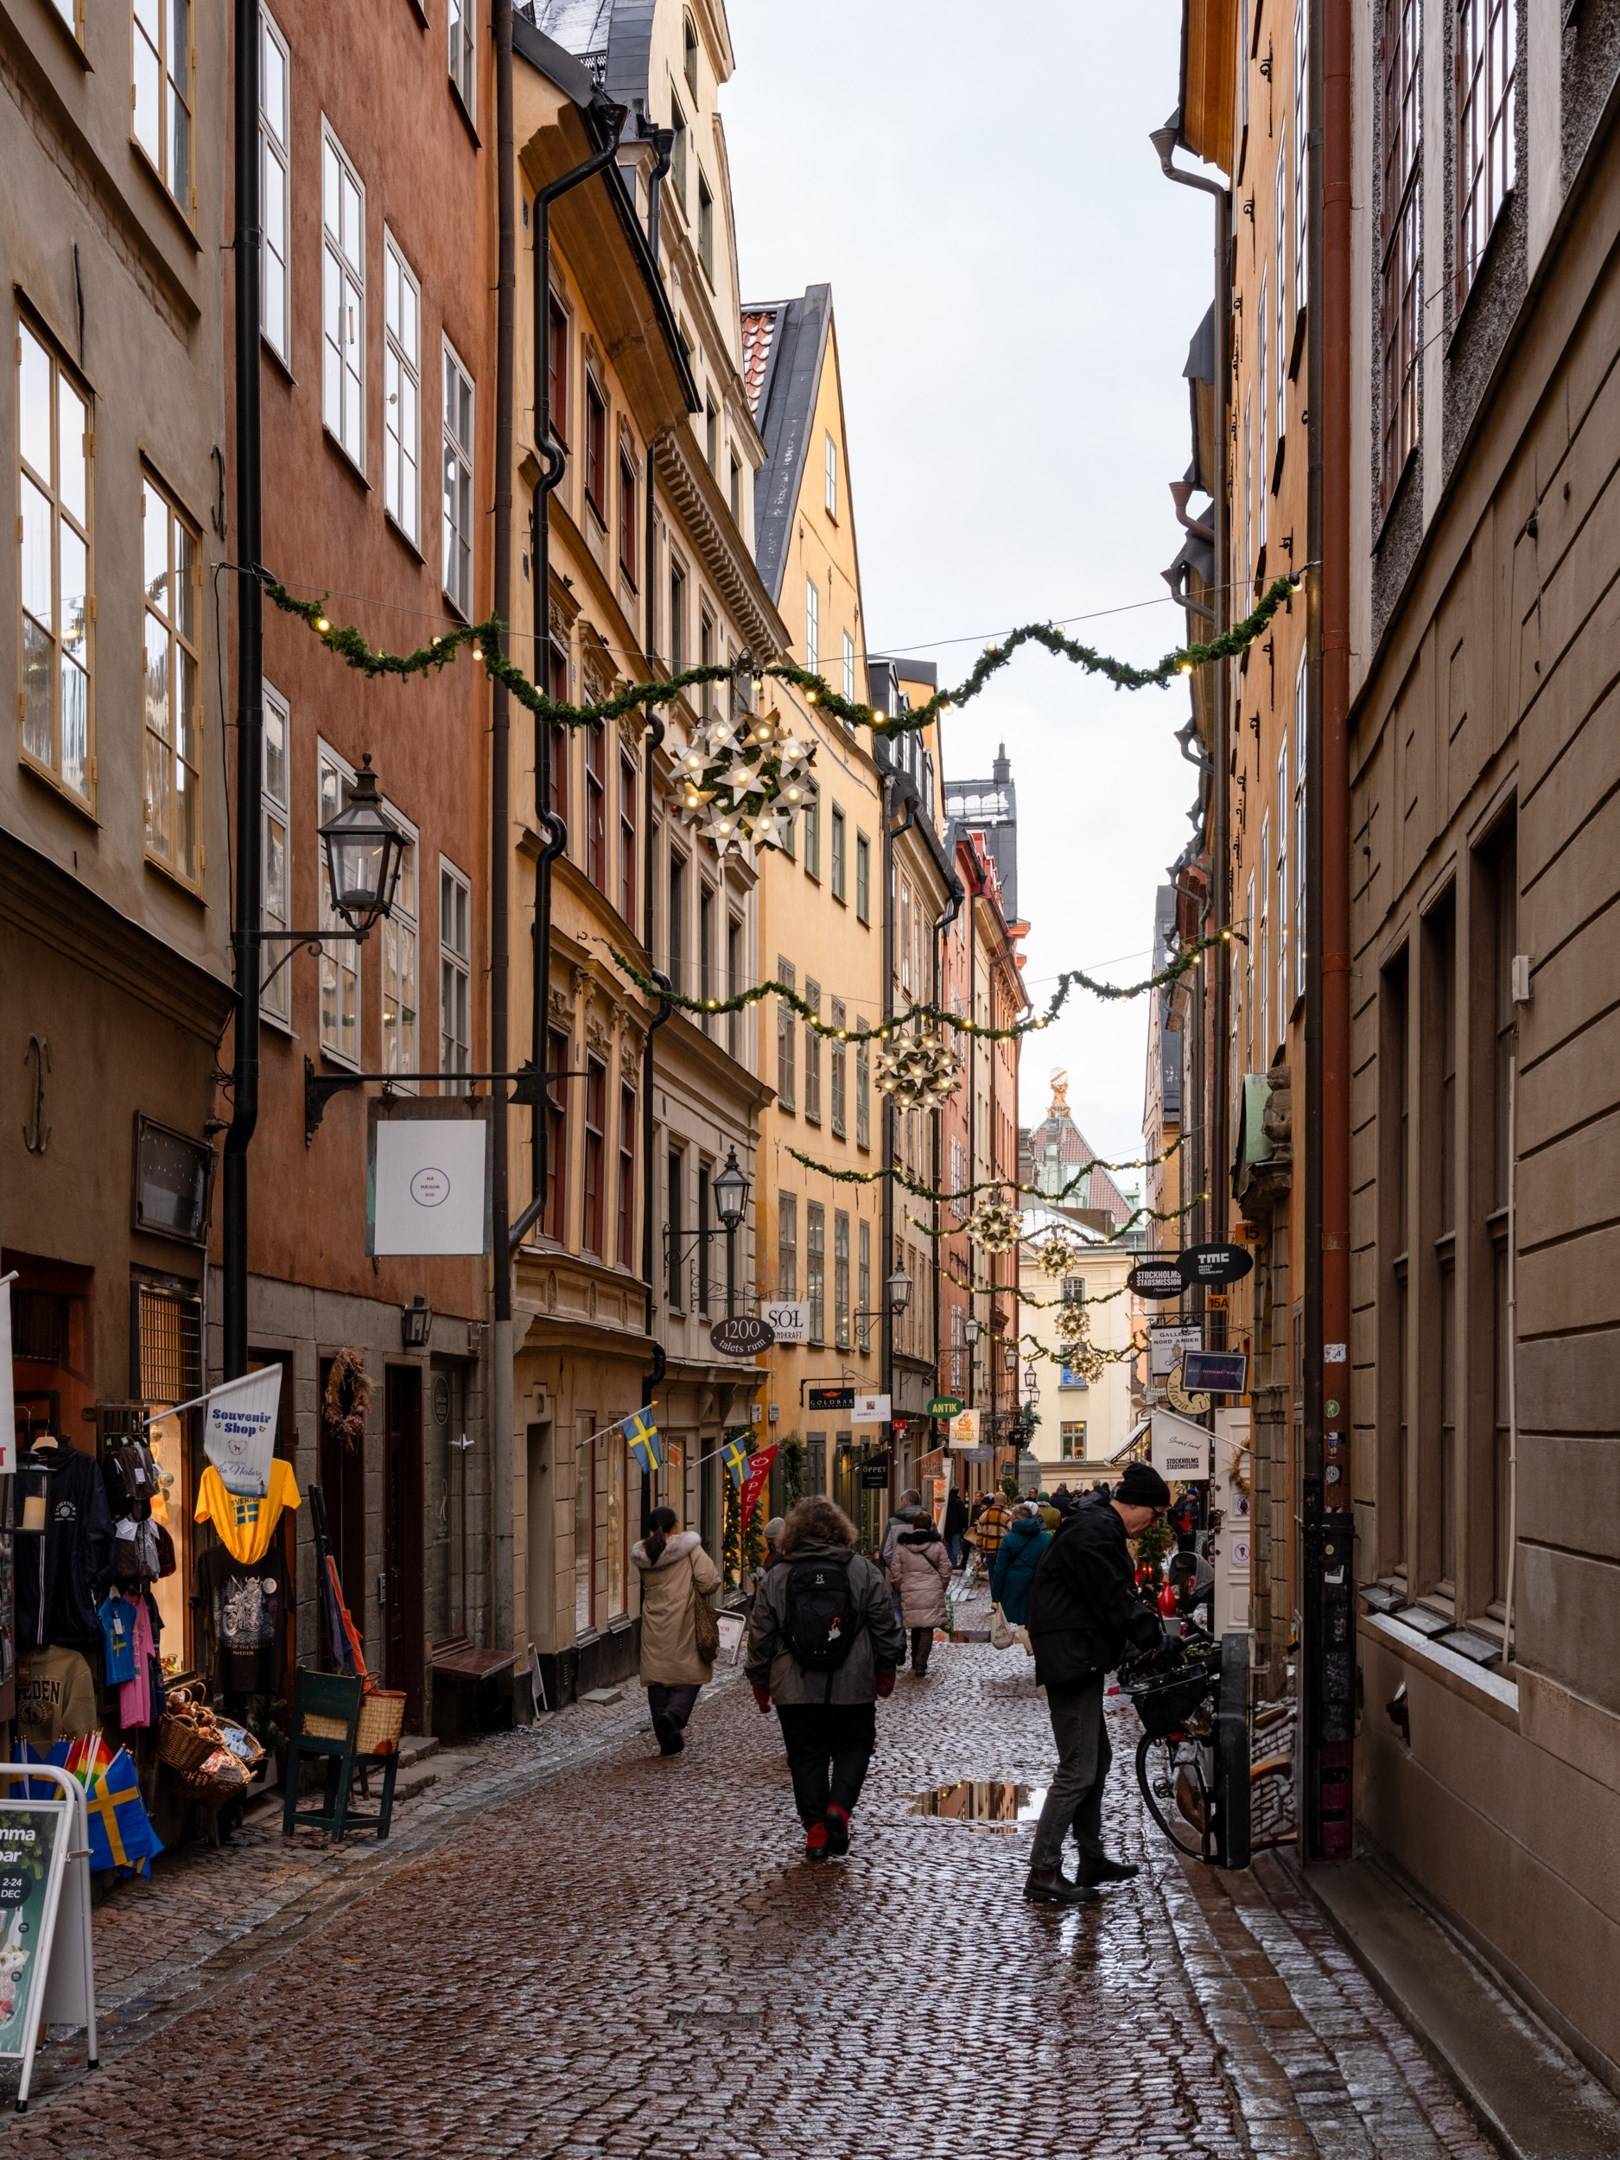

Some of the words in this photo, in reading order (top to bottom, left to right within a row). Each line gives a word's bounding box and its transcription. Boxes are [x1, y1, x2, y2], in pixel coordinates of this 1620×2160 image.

[1244, 1225, 1260, 1240] 15
[1198, 1253, 1230, 1264] TMC
[1136, 1270, 1181, 1279] STOCKHOLMS
[1210, 1298, 1228, 1308] 15A
[725, 1319, 760, 1339] 1200
[774, 1331, 802, 1339] ANDKRAFT
[719, 1339, 744, 1353] talets
[747, 1339, 767, 1352] rum
[1169, 1382, 1189, 1411] Maria
[932, 1403, 957, 1413] ANTIK
[212, 1408, 272, 1424] Souvenir
[223, 1422, 256, 1438] Shop
[863, 1465, 887, 1473] ÖPPET
[745, 1456, 769, 1514] ÖPPET
[0, 1850, 22, 1863] ar
[1, 1890, 21, 1898] DEC
